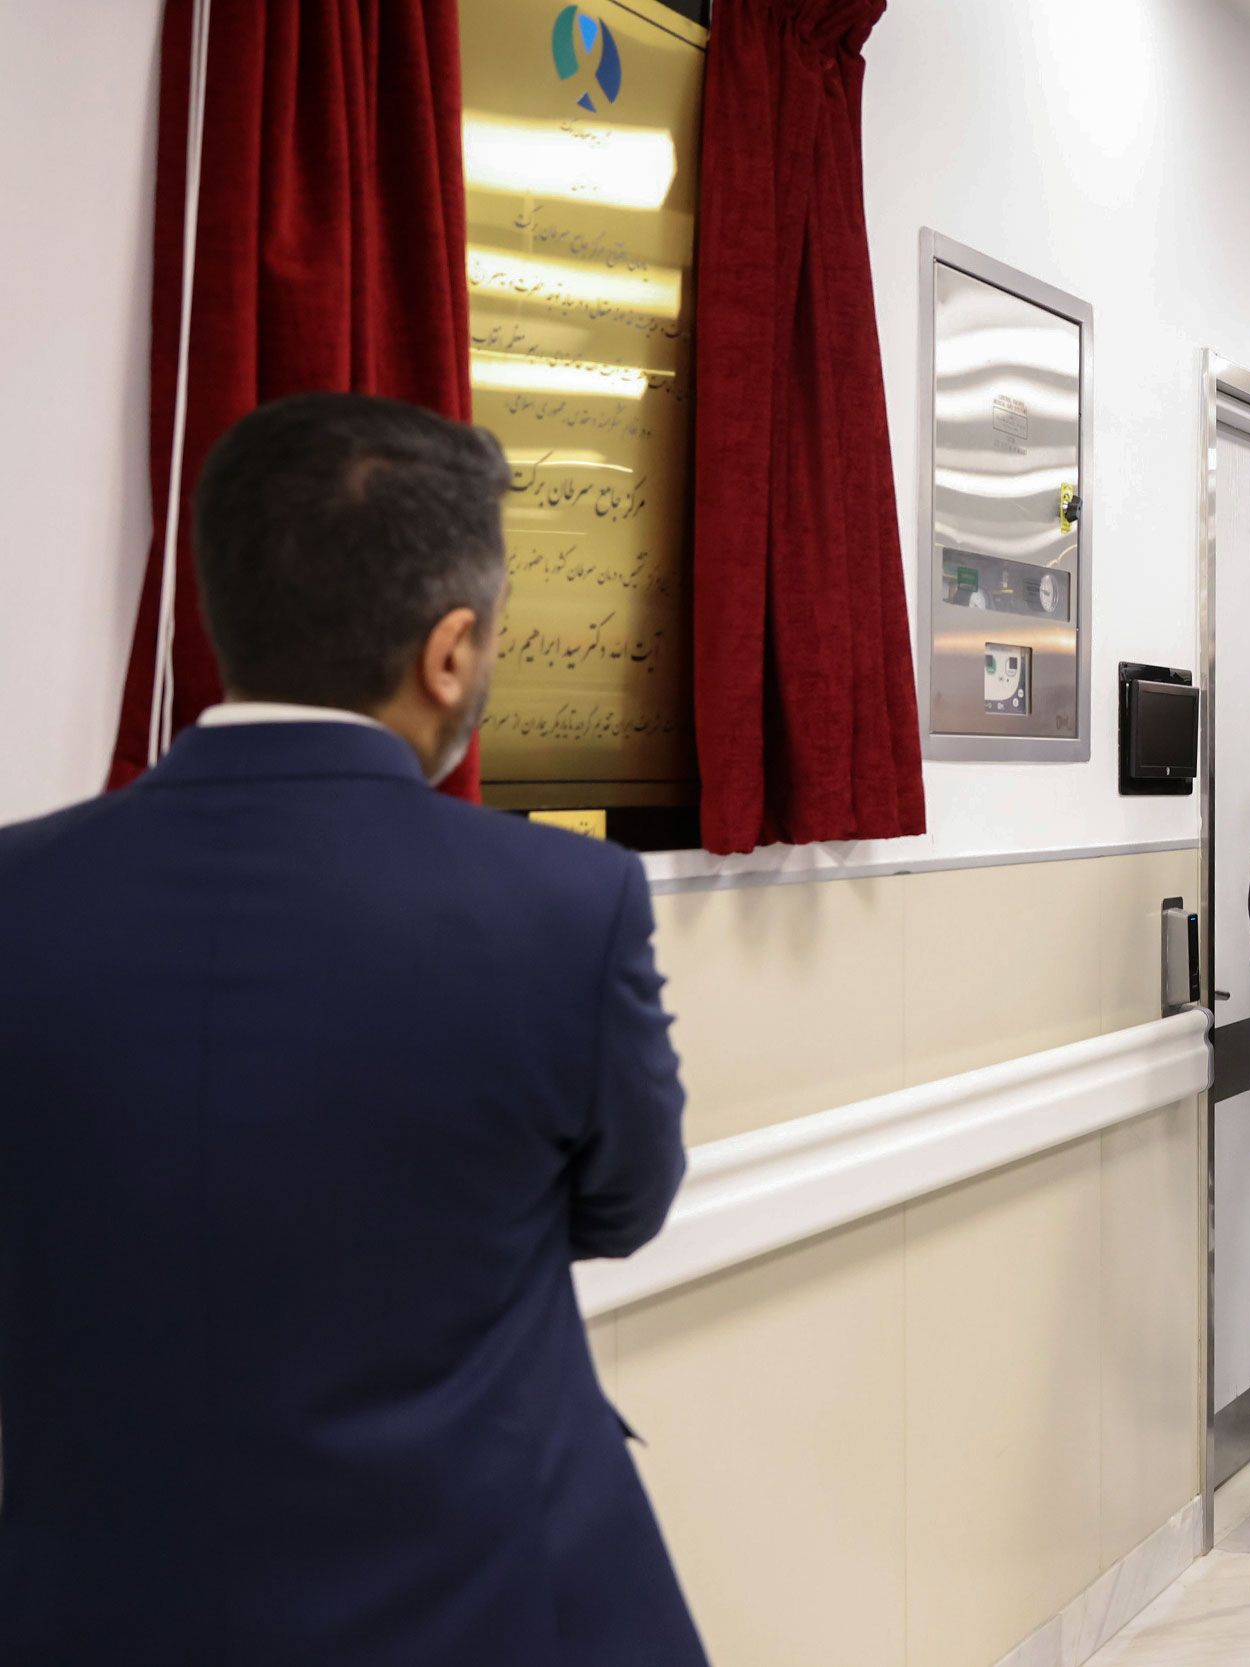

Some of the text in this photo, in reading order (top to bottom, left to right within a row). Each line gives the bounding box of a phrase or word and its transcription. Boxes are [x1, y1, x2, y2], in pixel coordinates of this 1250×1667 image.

[508, 449, 648, 523] مرکز جامع سرطان برکت
[517, 625, 560, 674] ابراهیم
[560, 644, 580, 670] سید
[579, 609, 615, 663] دکتر
